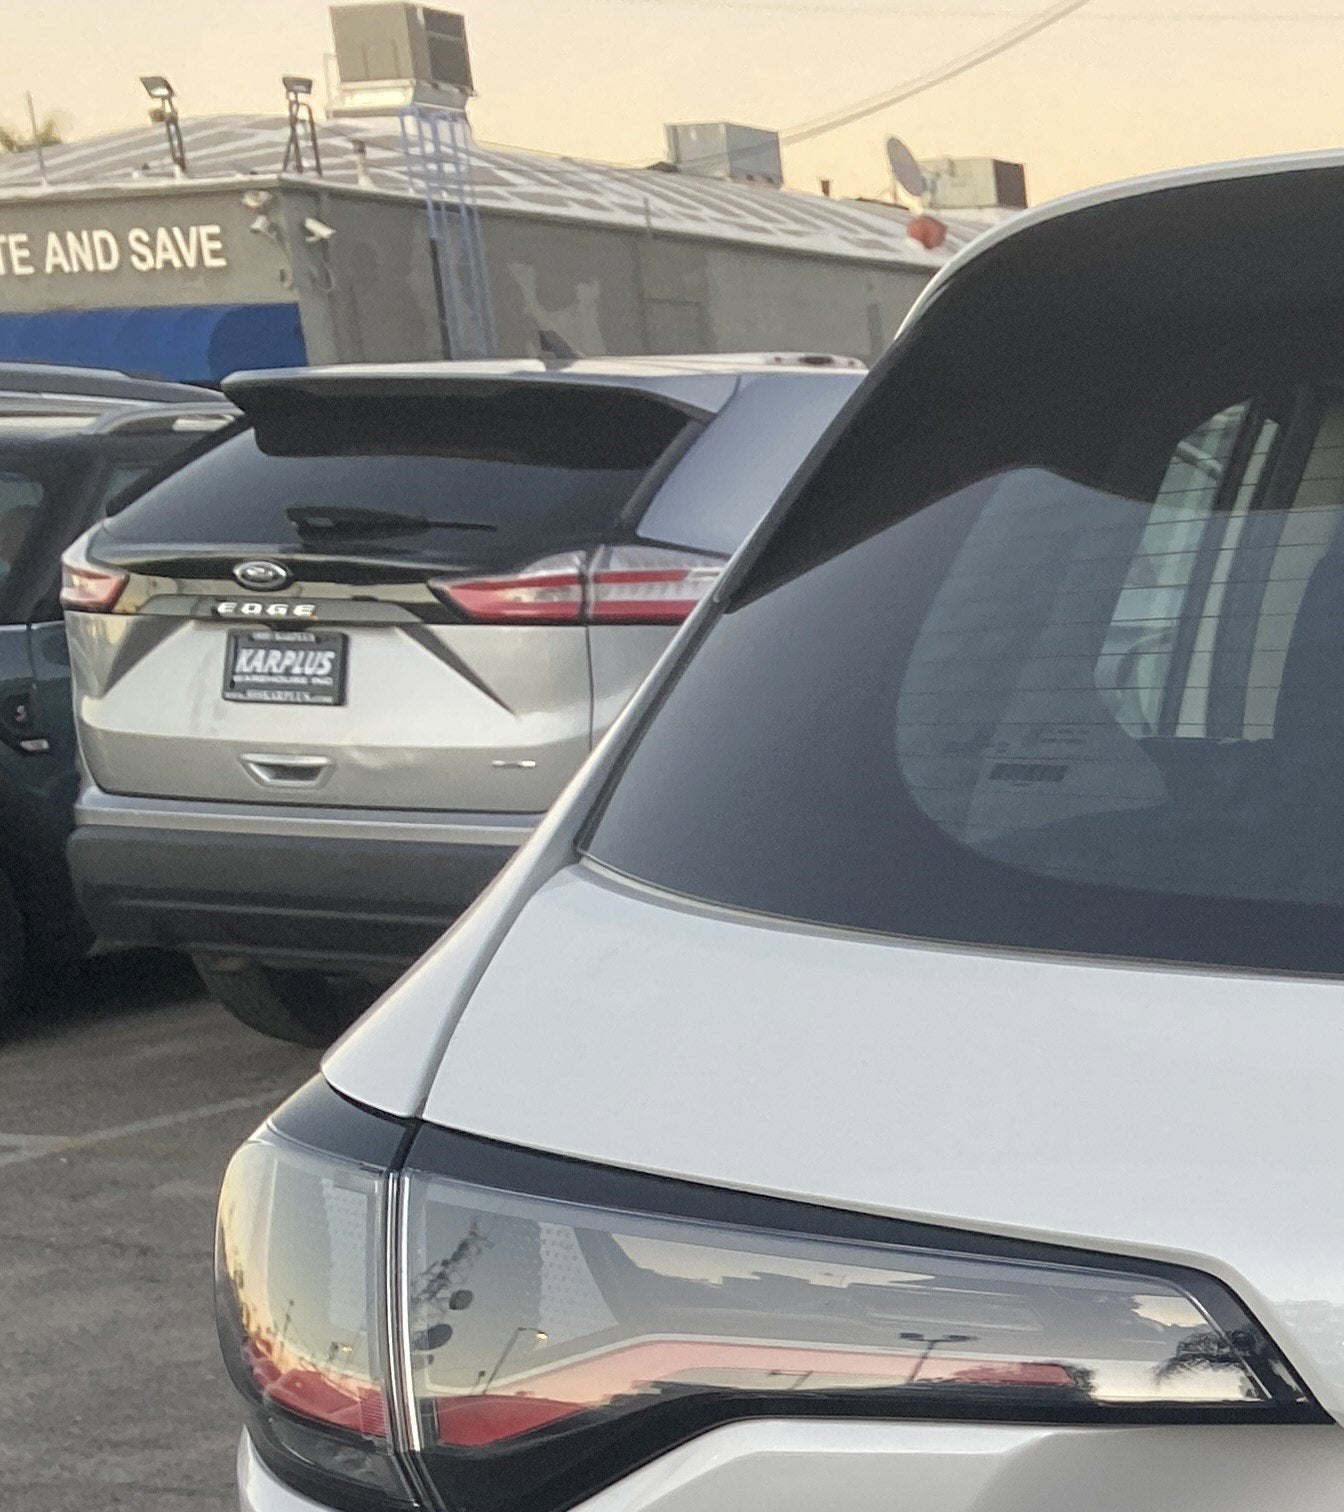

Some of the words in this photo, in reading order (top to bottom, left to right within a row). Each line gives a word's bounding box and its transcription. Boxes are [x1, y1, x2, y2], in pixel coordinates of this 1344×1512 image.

[44, 228, 120, 274] AND
[128, 224, 228, 272] SAVE
[217, 602, 317, 618] EDGE
[235, 647, 336, 675] KARPLUS
